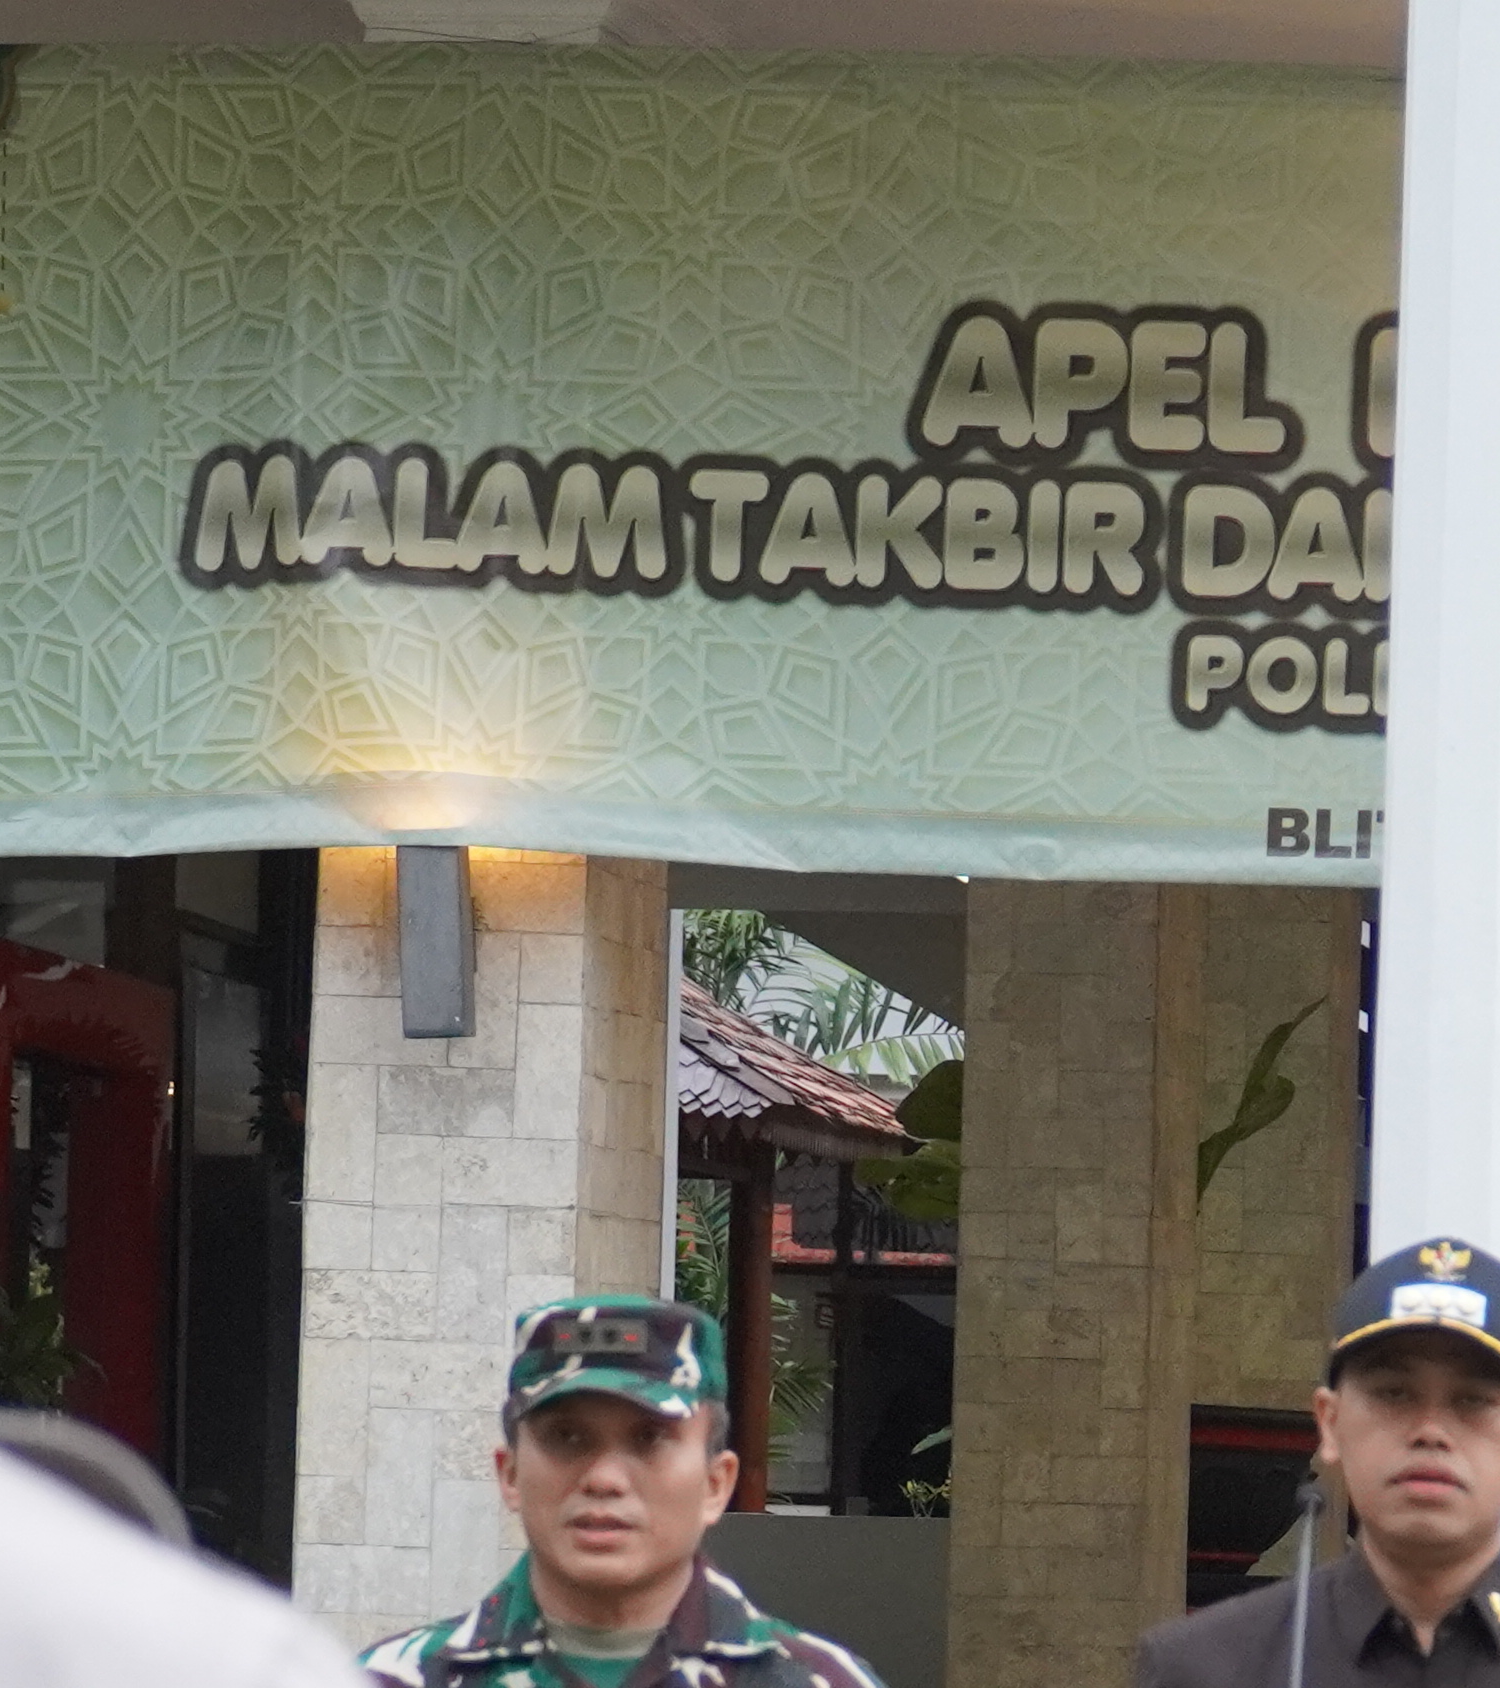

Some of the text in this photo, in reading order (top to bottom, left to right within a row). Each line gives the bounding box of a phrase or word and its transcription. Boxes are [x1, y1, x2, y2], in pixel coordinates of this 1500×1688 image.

[921, 315, 1287, 453] APEL
[194, 456, 666, 579] MALAM
[689, 470, 1145, 596] TAKBIR
